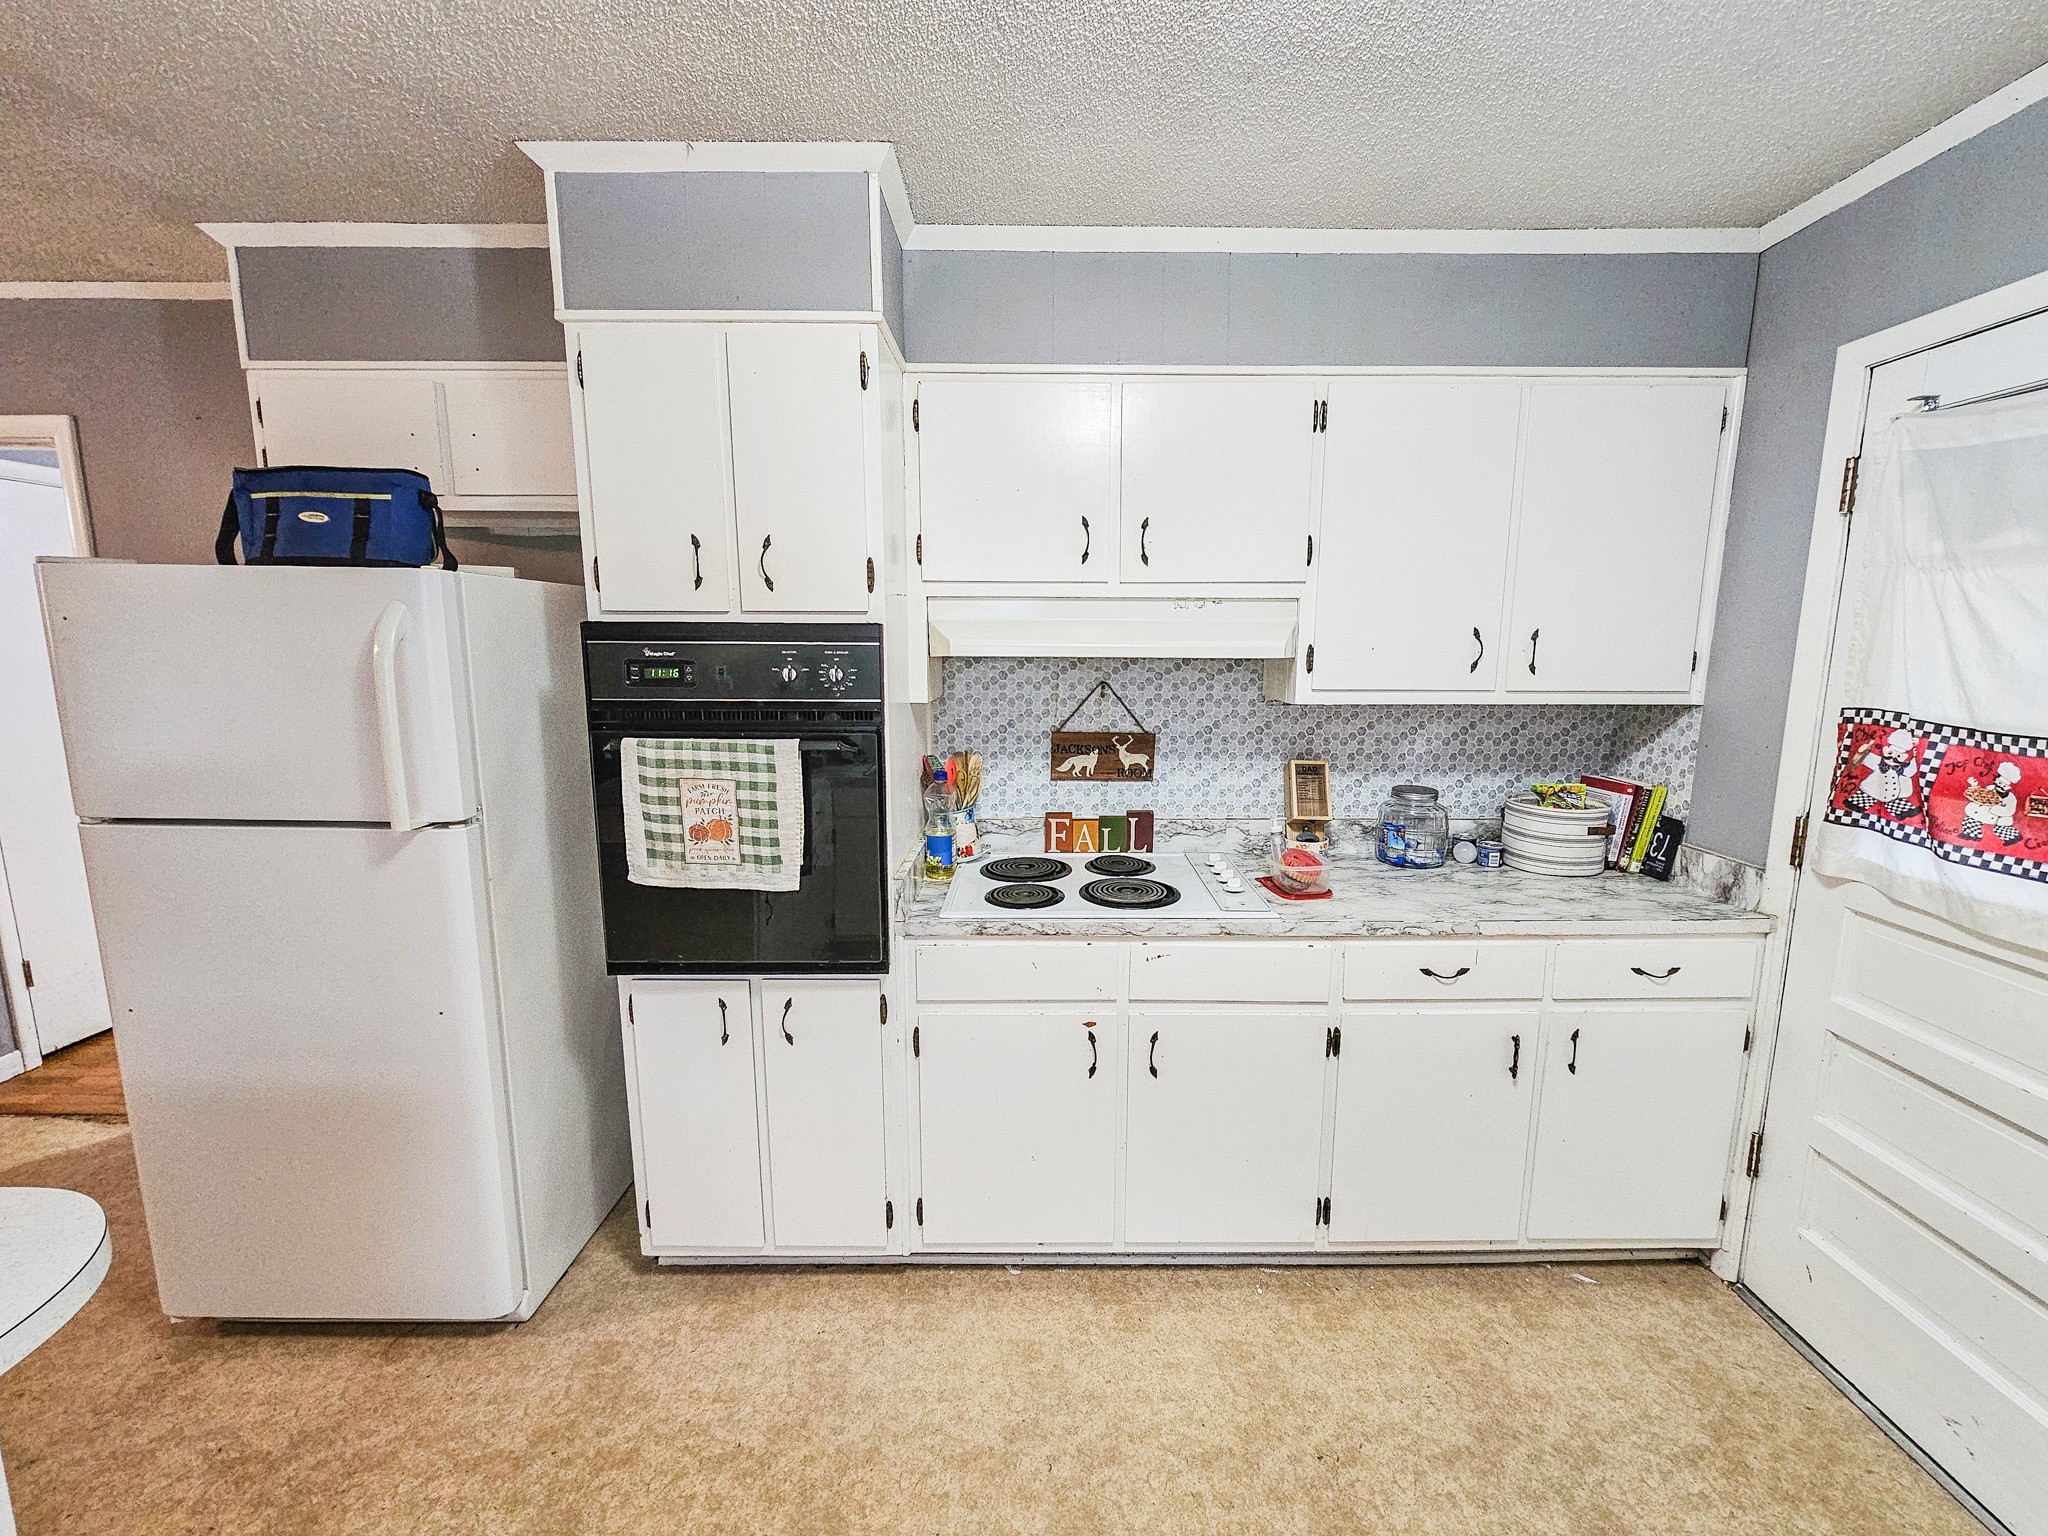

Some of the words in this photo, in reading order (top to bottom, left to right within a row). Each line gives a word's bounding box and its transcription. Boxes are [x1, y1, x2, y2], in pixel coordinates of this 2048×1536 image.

[651, 668, 680, 677] 11:16
[1053, 743, 1116, 755] JACKSONS
[1117, 768, 1153, 778] ROOM
[687, 783, 705, 794] FARM
[707, 783, 730, 795] FRESH
[695, 807, 725, 815] PATCH
[1047, 817, 1148, 854] FALL
